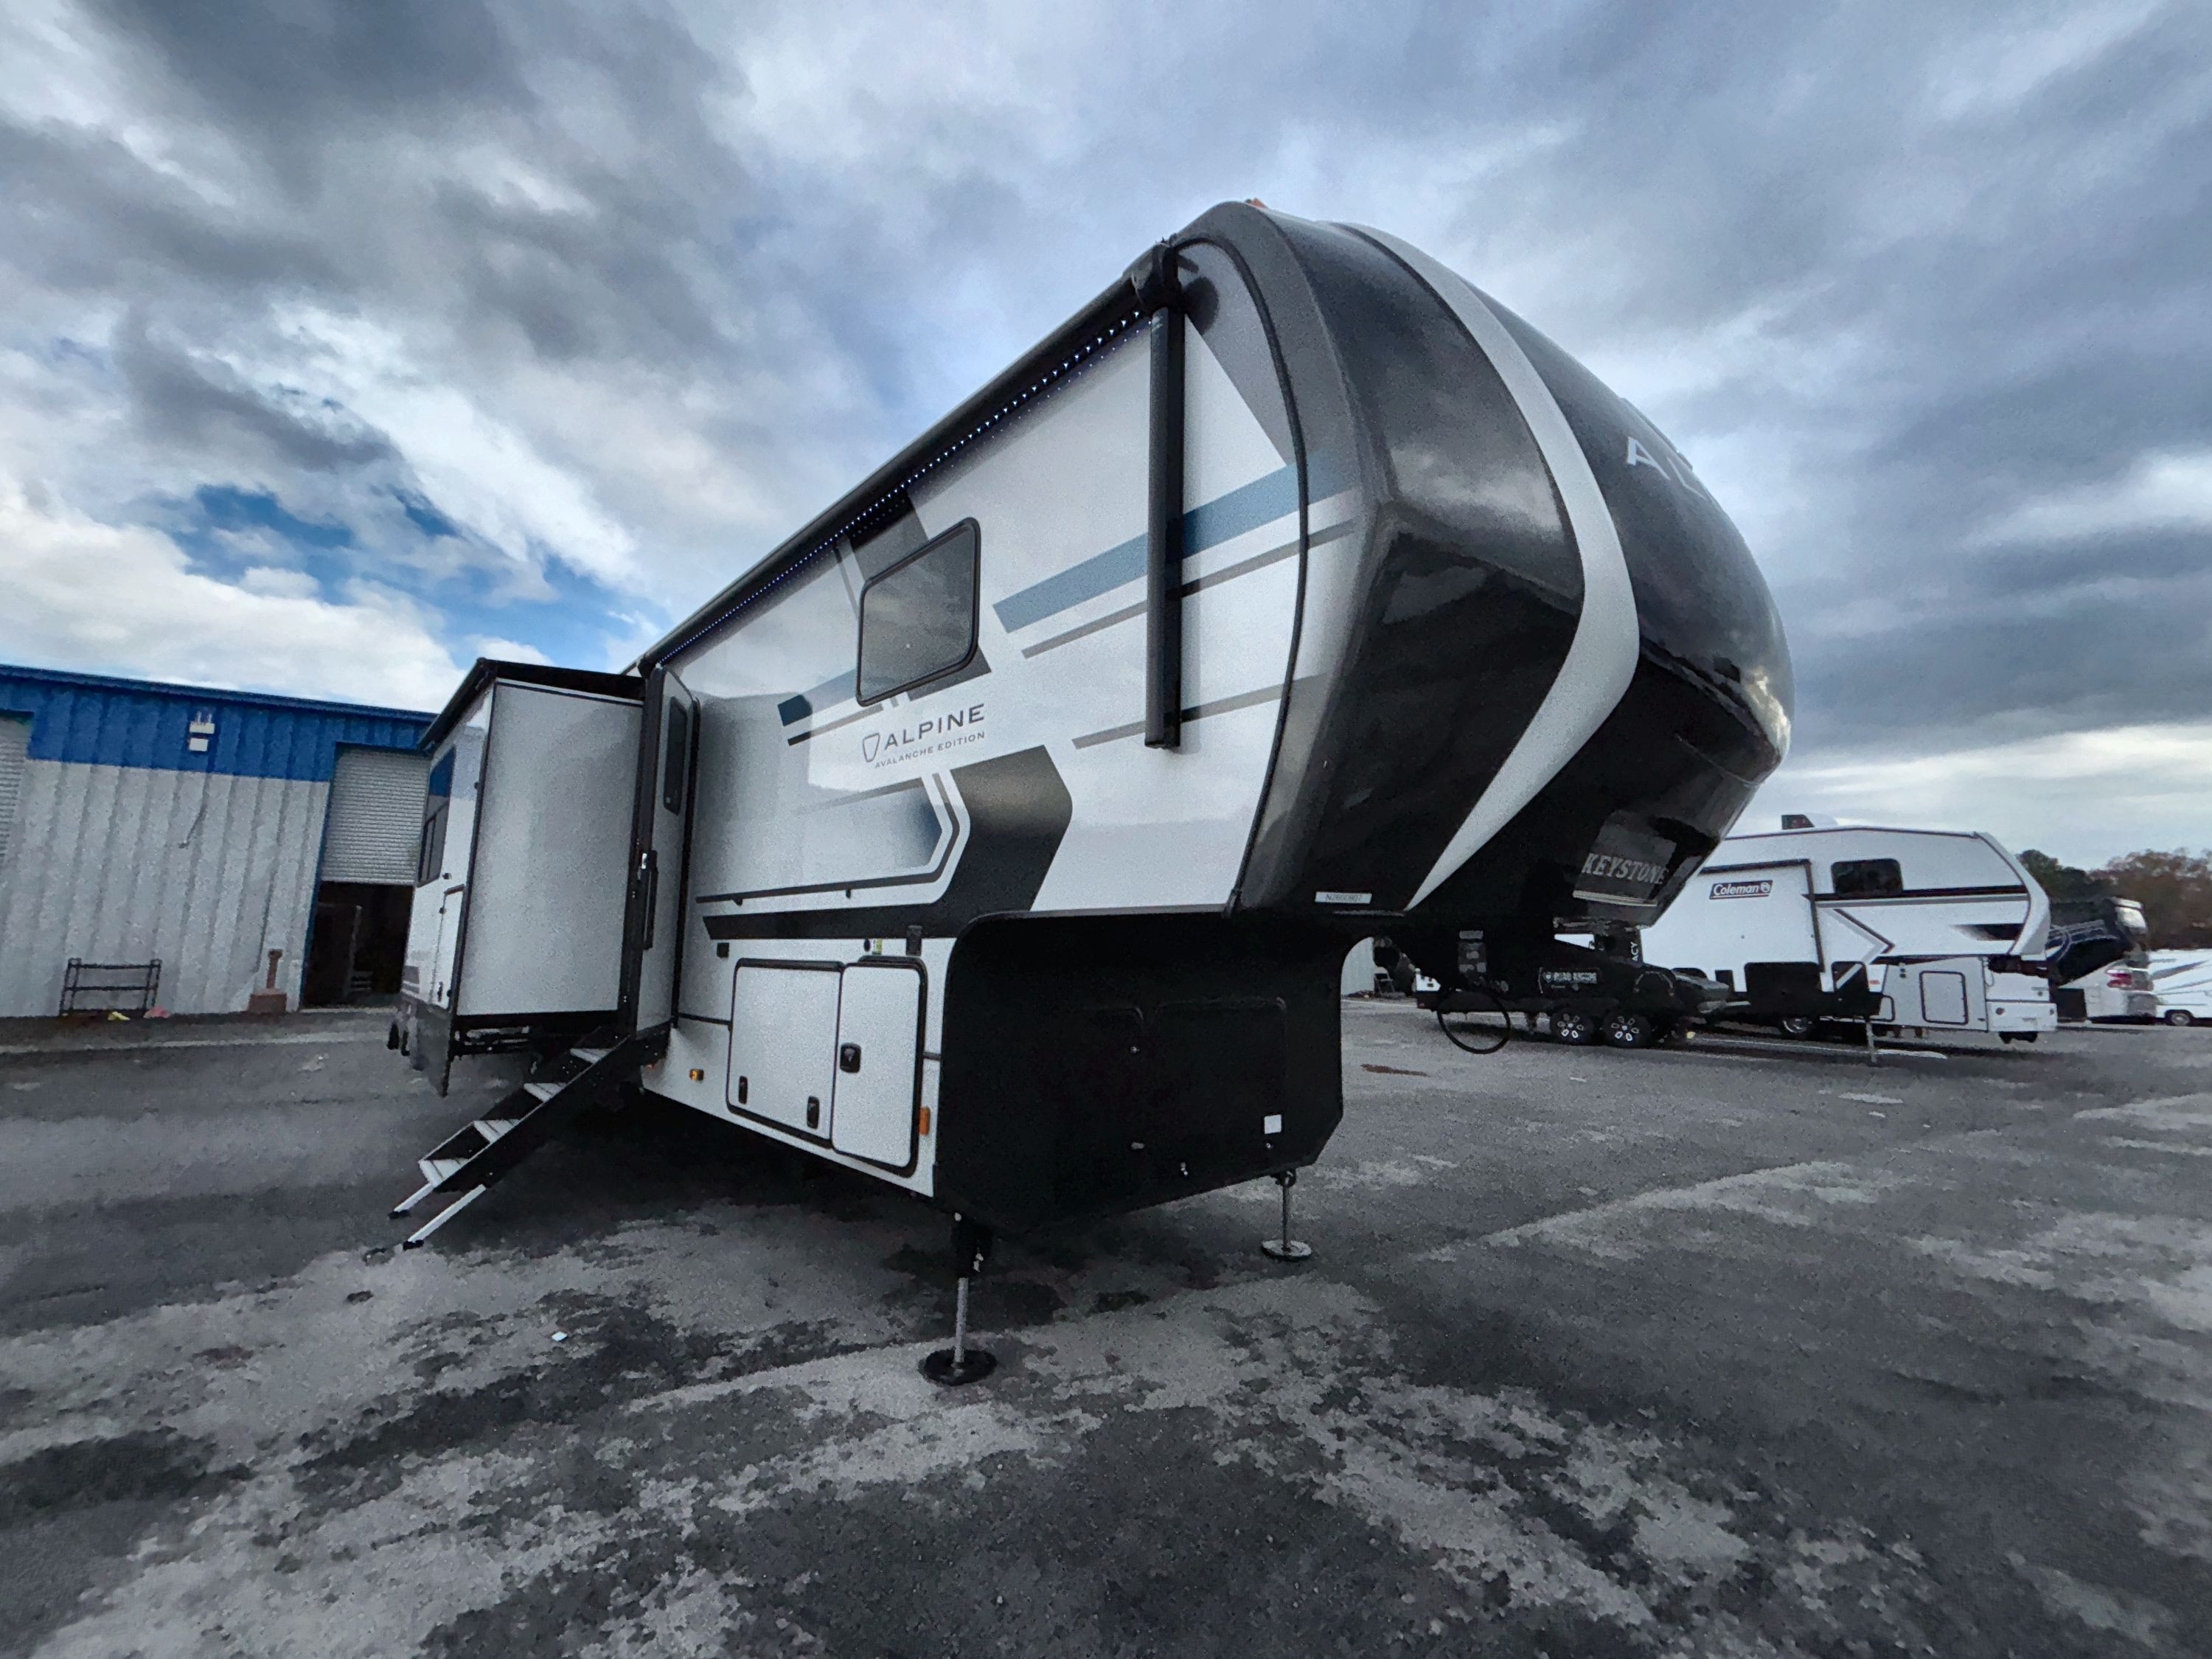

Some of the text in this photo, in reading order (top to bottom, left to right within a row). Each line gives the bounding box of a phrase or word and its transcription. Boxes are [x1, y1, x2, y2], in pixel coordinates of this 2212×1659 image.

[885, 704, 984, 750] ALPINE
[875, 732, 984, 768] AVALANCHE EDITION
[1582, 853, 1668, 884] KEYSTONE
[1713, 883, 1759, 896] Coleman
